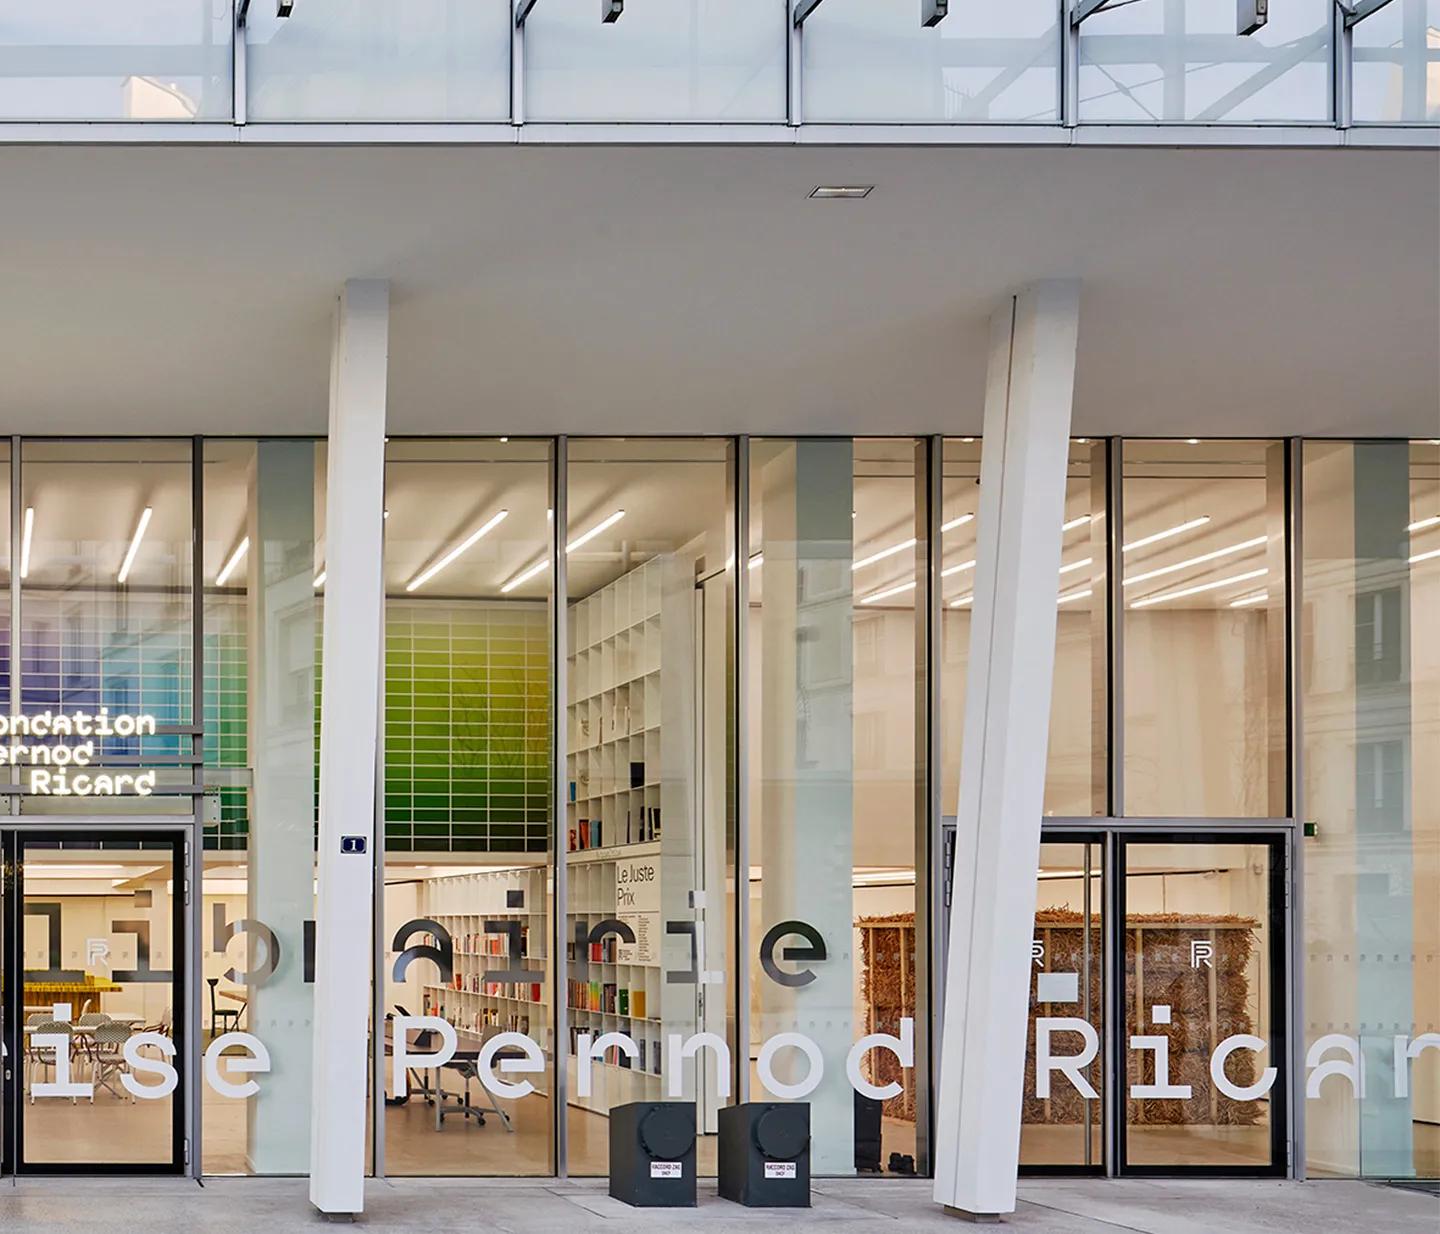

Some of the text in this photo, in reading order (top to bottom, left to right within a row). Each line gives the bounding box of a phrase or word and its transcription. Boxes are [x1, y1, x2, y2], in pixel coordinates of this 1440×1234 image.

[30, 768, 156, 796] Ricard
[350, 840, 357, 851] 1
[617, 864, 655, 884] Le Juste
[617, 887, 635, 906] Prix
[23, 890, 827, 987] libairie
[393, 1016, 914, 1100] Pernod
